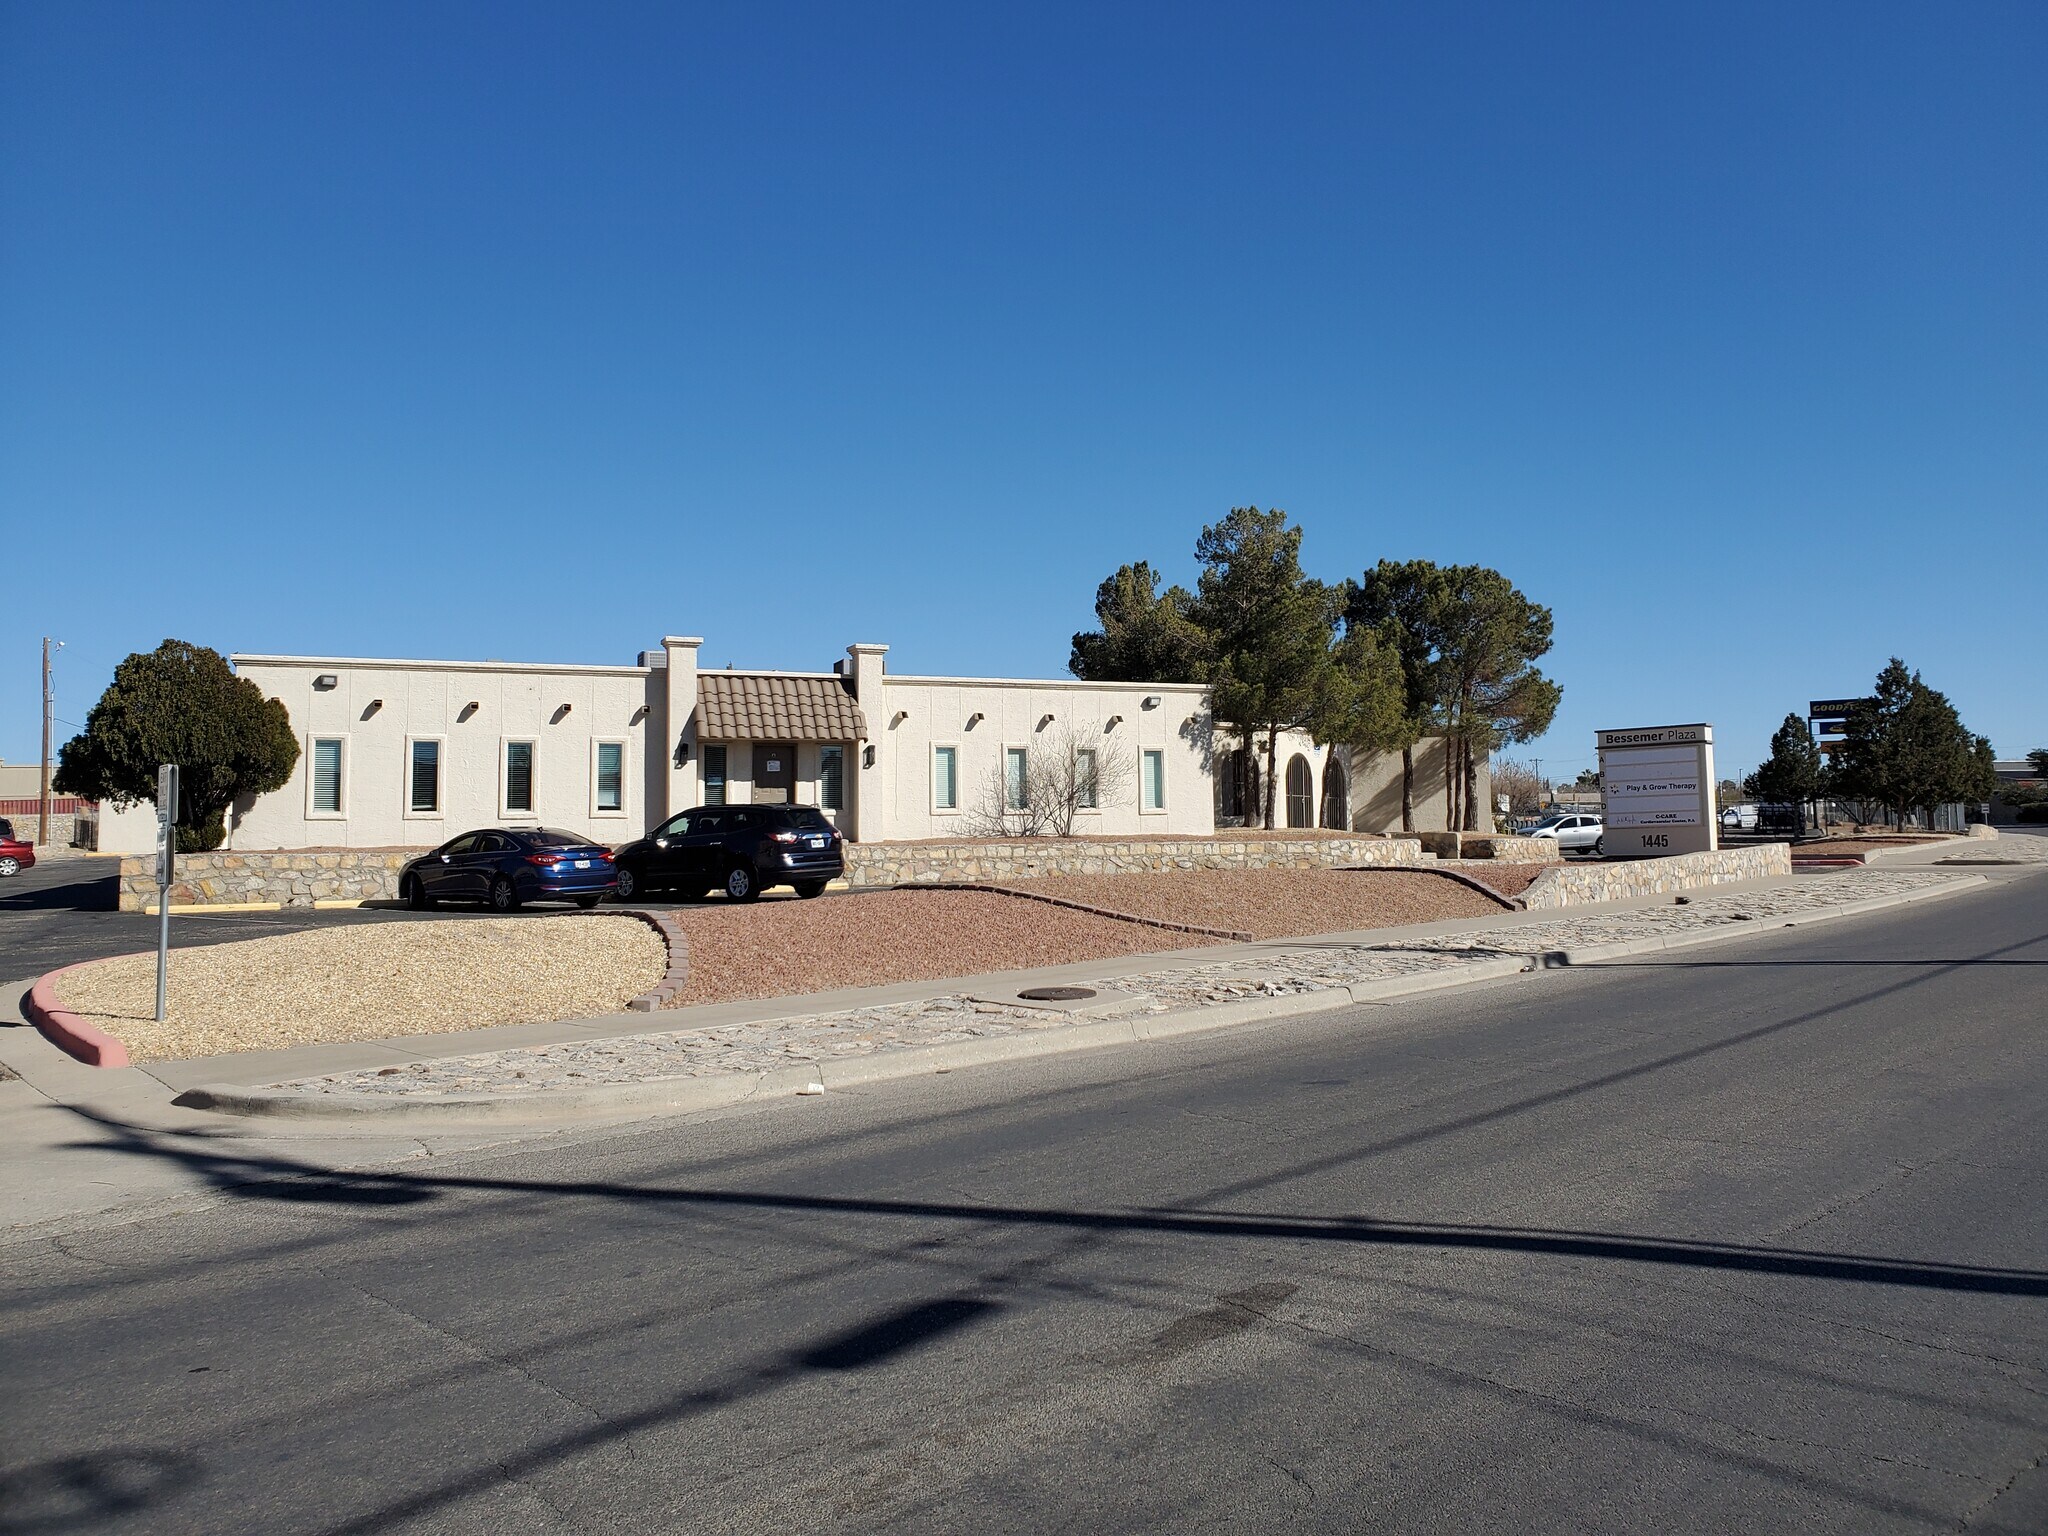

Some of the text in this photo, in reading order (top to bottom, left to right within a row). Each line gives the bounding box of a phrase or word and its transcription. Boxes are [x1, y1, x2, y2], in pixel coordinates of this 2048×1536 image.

[1606, 730, 1697, 744] Bessemer Plaza
[1641, 834, 1669, 848] 1445
